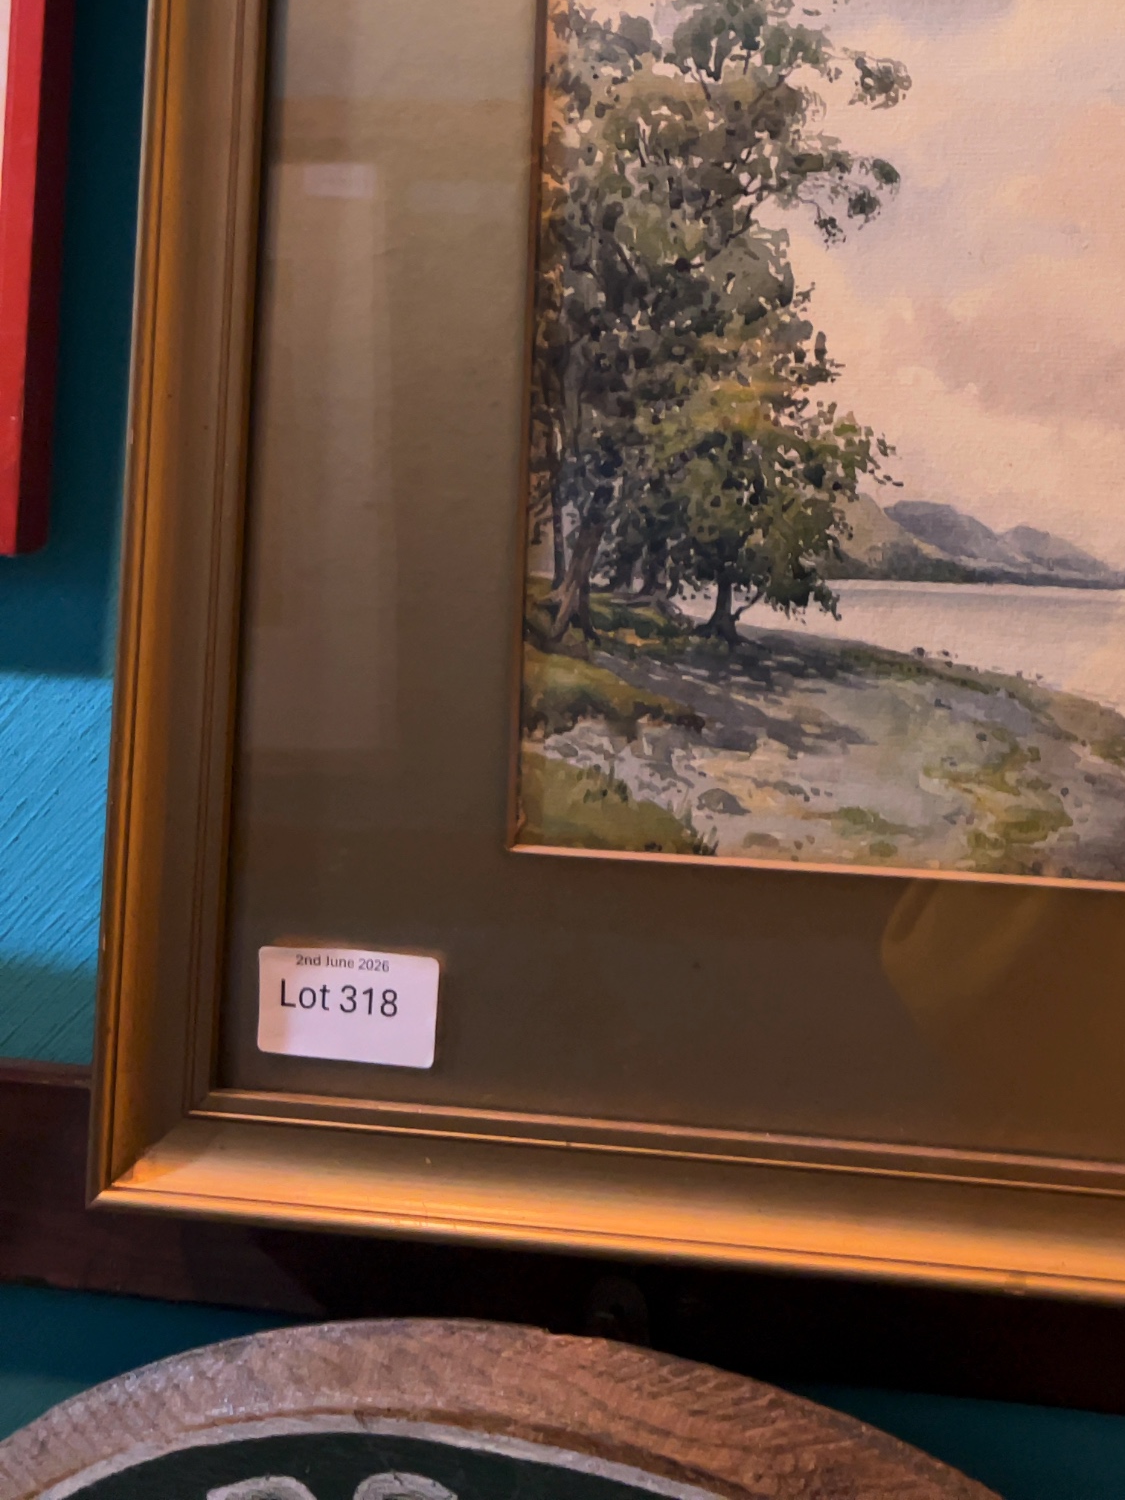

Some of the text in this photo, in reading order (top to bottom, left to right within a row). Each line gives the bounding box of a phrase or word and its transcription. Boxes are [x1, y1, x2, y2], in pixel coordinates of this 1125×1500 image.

[295, 954, 390, 973] 2nd June 2026
[280, 978, 398, 1017] Lot 318
